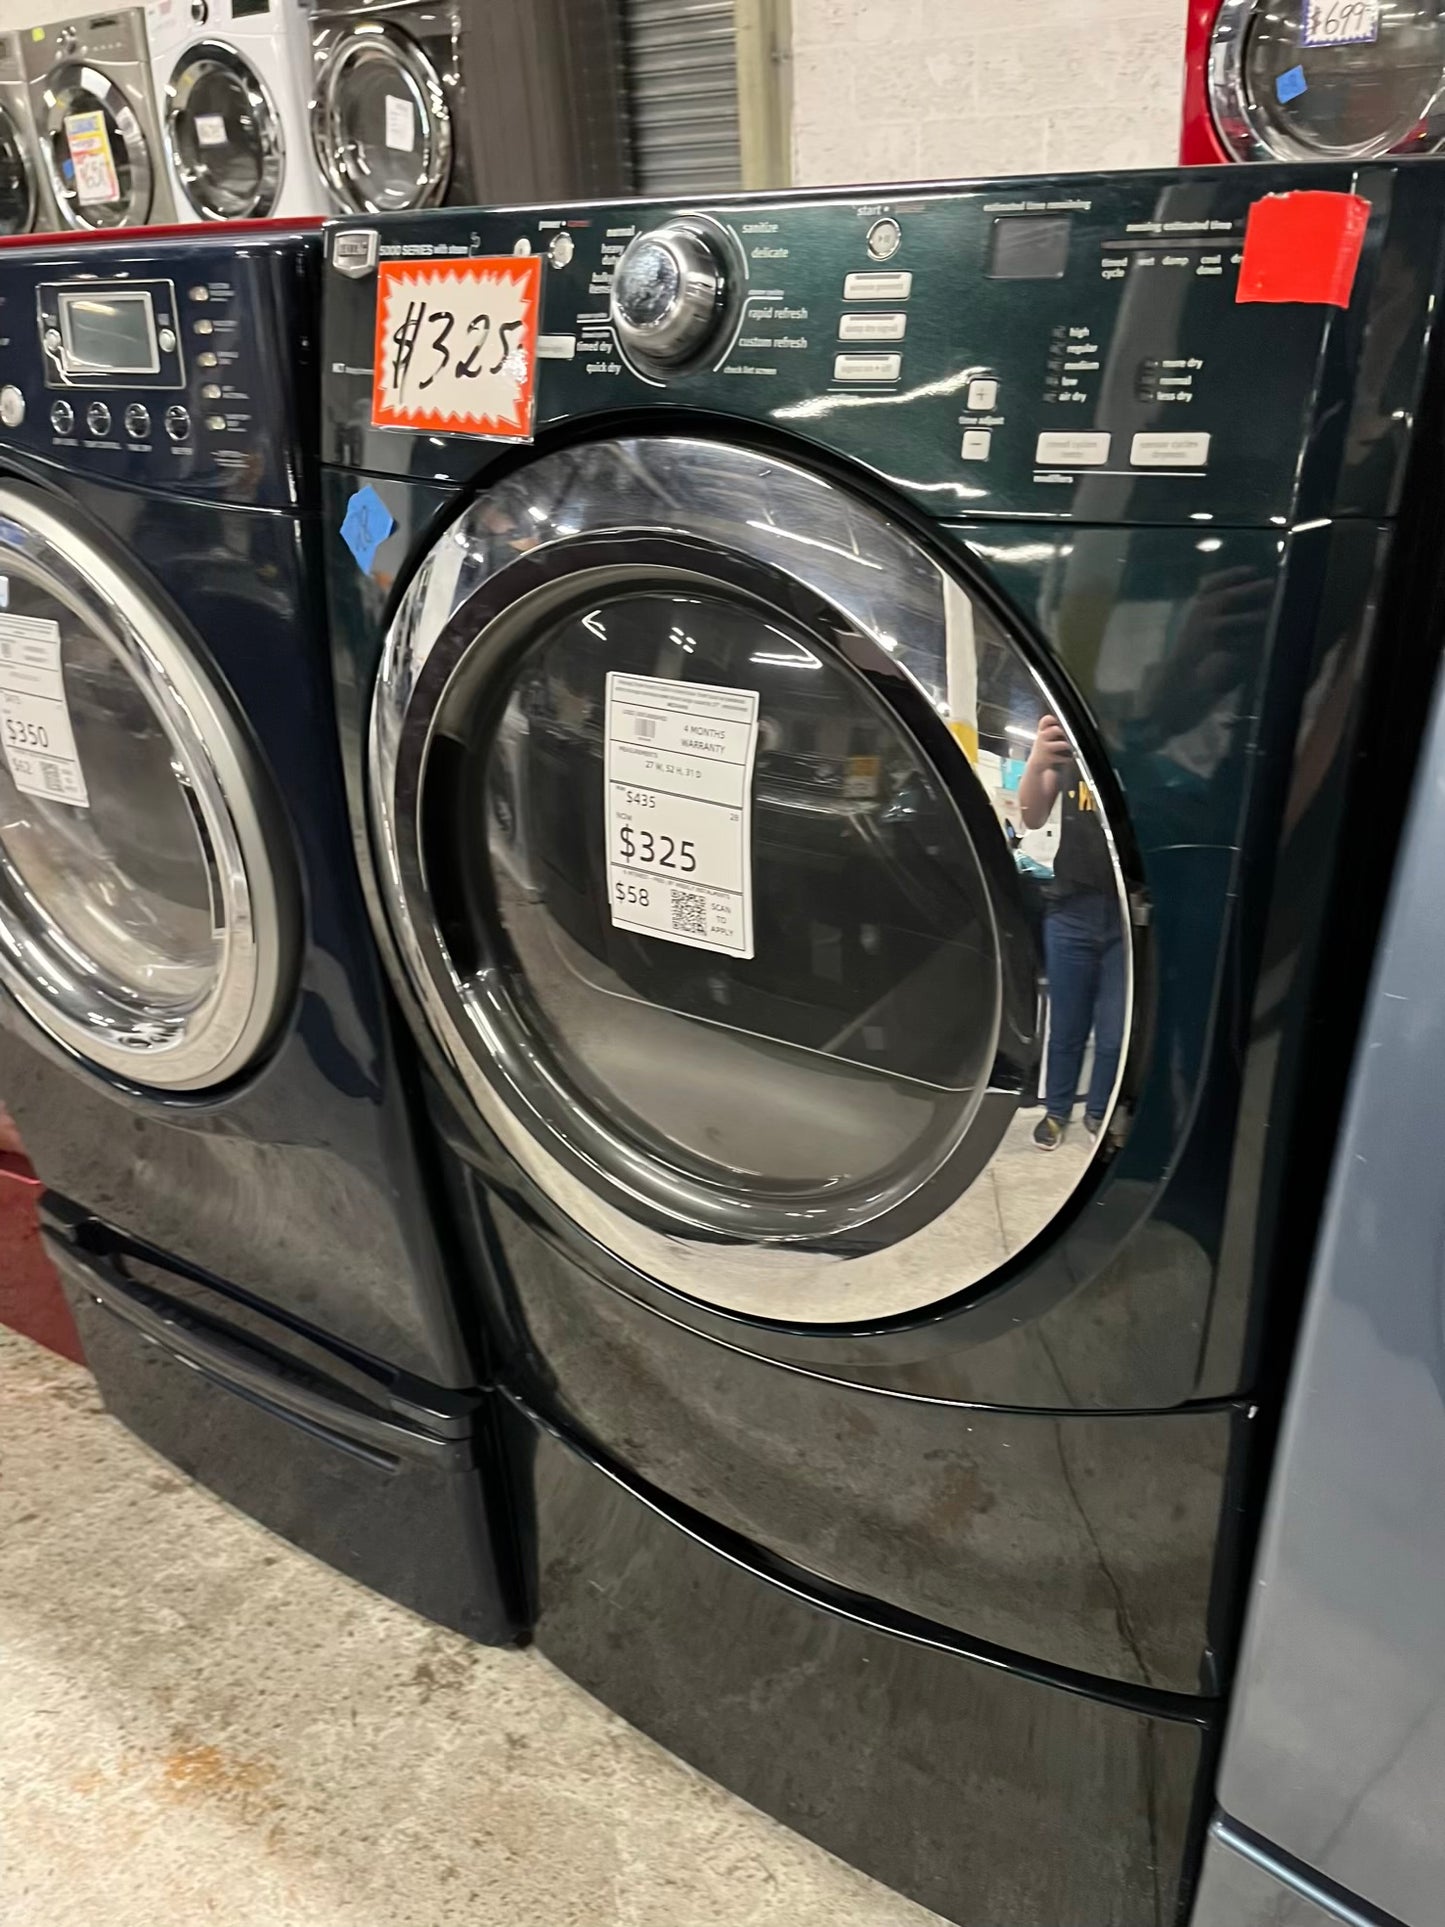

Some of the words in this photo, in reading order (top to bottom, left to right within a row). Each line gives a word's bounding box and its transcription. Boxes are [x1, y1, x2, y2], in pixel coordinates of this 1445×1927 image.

[1310, 1, 1366, 35] $699
[856, 205, 882, 216] start
[751, 247, 789, 259] delicate
[748, 307, 773, 321] rapid
[774, 307, 808, 319] refresh
[599, 341, 614, 354] dry
[738, 337, 772, 347] custom
[773, 336, 808, 348] refresh
[392, 302, 525, 403] $325
[586, 361, 607, 375] quick
[607, 362, 622, 375] dry
[7, 719, 48, 748] $350
[691, 726, 726, 740] MONTHS
[681, 739, 726, 754] WARRANTY
[645, 761, 654, 769] 27
[625, 790, 656, 808] $435
[620, 823, 697, 872] $325
[615, 880, 650, 907] $58
[711, 902, 732, 914] SCAN
[716, 915, 727, 924] TO
[710, 926, 733, 937] APPLY
